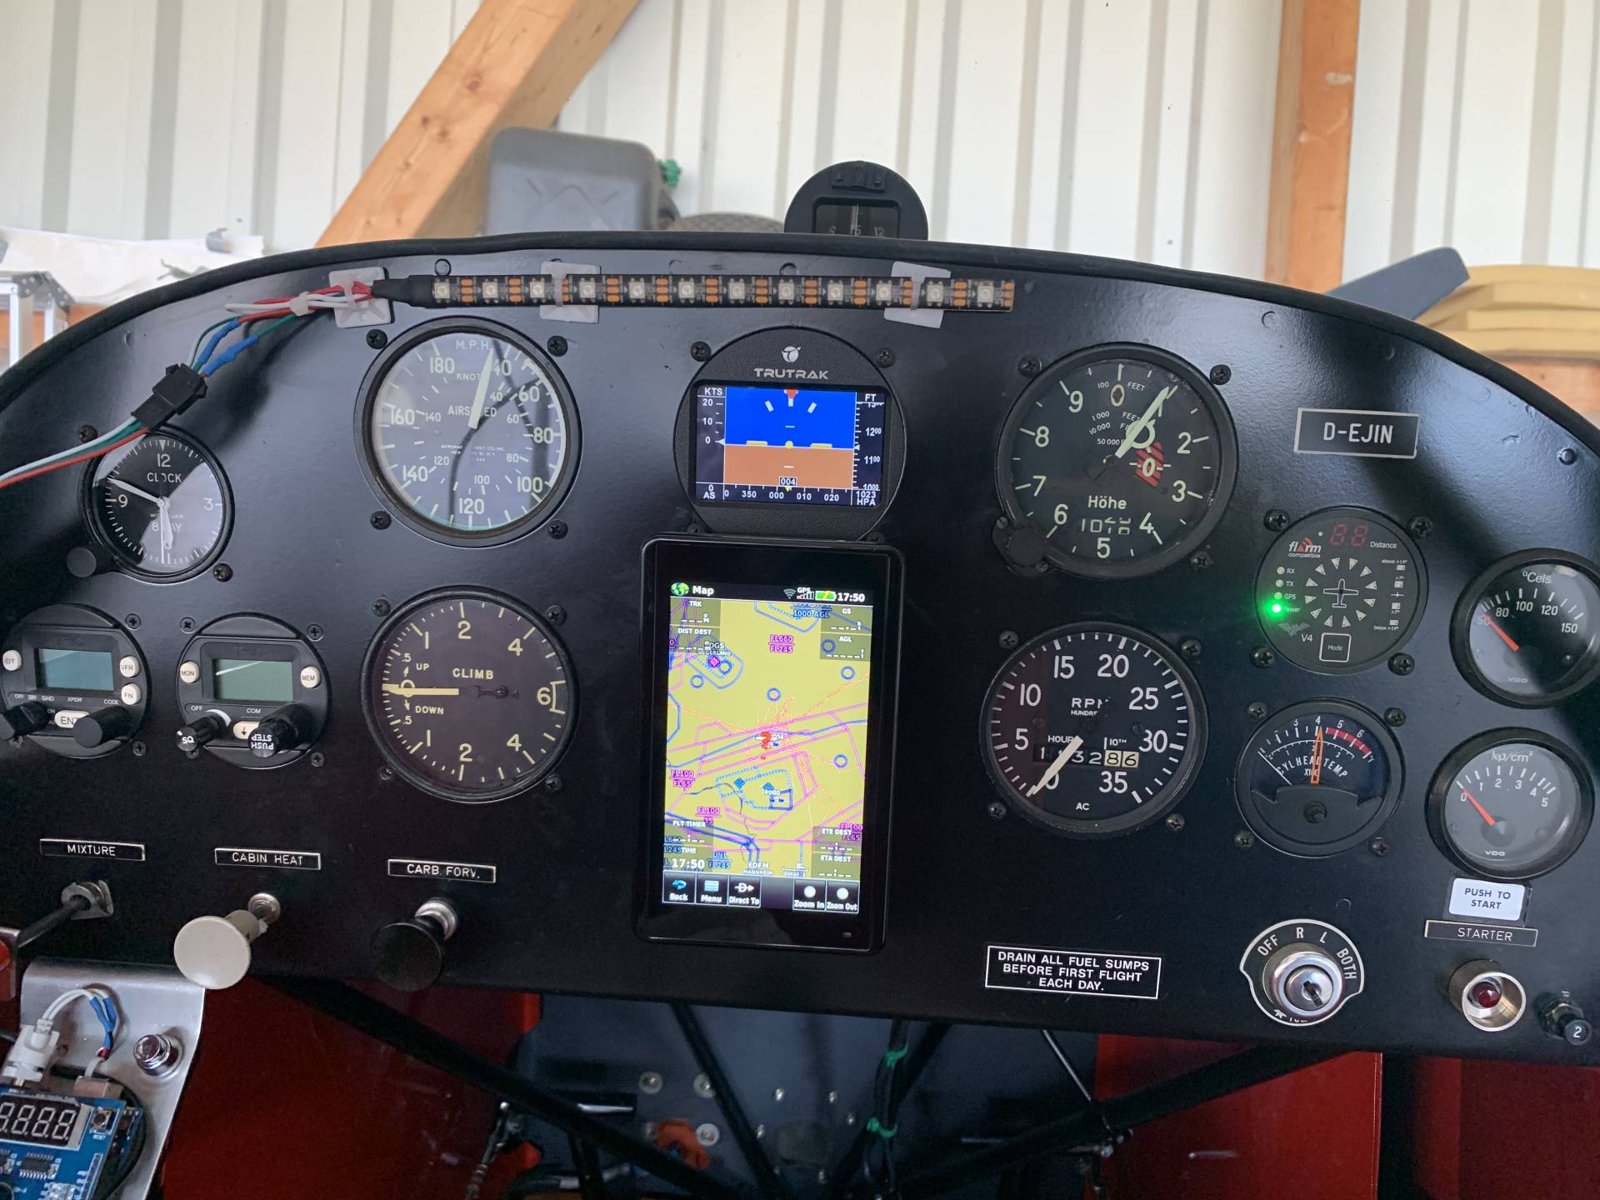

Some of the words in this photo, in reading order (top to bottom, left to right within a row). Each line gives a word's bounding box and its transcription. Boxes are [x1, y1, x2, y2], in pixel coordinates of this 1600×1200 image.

[456, 340, 493, 350] M.P.H.
[429, 357, 455, 374] 180
[492, 359, 512, 376] 40
[753, 368, 829, 380] TRUTRAK
[704, 387, 723, 396] KTS
[1097, 381, 1110, 389] 100
[1127, 381, 1146, 392] FEET
[490, 392, 503, 401] 40
[519, 385, 540, 402] 60
[865, 394, 877, 402] FT
[1110, 384, 1125, 407] 0
[1068, 391, 1084, 412] 9
[390, 409, 415, 425] 160
[425, 412, 442, 422] 140
[448, 405, 497, 418] AIRSED
[506, 414, 520, 424] 60
[702, 417, 713, 425] 10
[533, 428, 554, 444] 80
[865, 427, 882, 436] 1200
[1035, 426, 1050, 448] 8
[1323, 422, 1394, 444] D-EJIN
[705, 436, 711, 444] 0
[1177, 432, 1190, 454] 2
[157, 453, 172, 468] 12
[434, 456, 450, 465] 120
[506, 453, 519, 462] 80
[1142, 458, 1156, 477] 0
[403, 466, 428, 482] 140
[474, 475, 490, 485] 100
[517, 477, 543, 492] 100
[780, 478, 796, 486] 004
[1033, 476, 1046, 496] 7
[703, 492, 716, 500] AS
[742, 490, 757, 498] 350
[769, 491, 784, 499] 000
[796, 492, 812, 500] 010
[856, 491, 876, 499] 1023
[1172, 480, 1187, 502] 3
[118, 494, 128, 508] 9
[824, 493, 840, 502] 020
[1088, 496, 1127, 510] Höhe
[203, 498, 214, 511] 3
[459, 498, 485, 514] 120
[1054, 504, 1068, 525] 6
[151, 522, 160, 532] 8
[1139, 512, 1154, 534] 4
[1096, 537, 1110, 558] 5
[1370, 541, 1398, 550] Distance
[692, 586, 714, 596] Map
[838, 592, 866, 602] 17:50
[1516, 601, 1534, 612] 100
[1541, 604, 1558, 616] 120
[1496, 608, 1510, 618] 80
[458, 620, 472, 640] 2
[1561, 622, 1578, 634] 150
[425, 632, 430, 650] 1
[1301, 634, 1314, 642] V4
[508, 638, 523, 656] 4
[1328, 644, 1344, 652] Mode
[416, 663, 430, 671] UP
[1054, 656, 1075, 679] 15
[1097, 654, 1130, 678] 20
[302, 674, 316, 682] MEM
[452, 668, 494, 680] CLIMB
[537, 687, 551, 706] 6
[1020, 684, 1042, 706] 10
[1128, 687, 1159, 710] 25
[415, 706, 444, 715] DOWN
[1315, 716, 1321, 724] 4
[1338, 720, 1344, 728] 5
[251, 734, 272, 742] STEP
[426, 730, 431, 747] 1
[1014, 728, 1029, 750] 5
[1356, 729, 1364, 738] 6
[251, 742, 274, 751] PUSH
[506, 734, 522, 752] 4
[1109, 738, 1128, 746] 10TH
[1138, 730, 1168, 754] 30
[459, 744, 472, 762] 2
[1276, 760, 1295, 775] CYL
[1324, 758, 1349, 778] TEMP
[1099, 771, 1128, 794] 35
[1479, 782, 1484, 792] 1
[1495, 778, 1502, 788] 2
[1515, 780, 1522, 790] 3
[1530, 787, 1537, 798] 4
[1076, 802, 1090, 811] AC
[1542, 798, 1548, 808] 5
[67, 844, 117, 857] MIXTURE
[232, 852, 268, 864] CABIN
[274, 854, 304, 866] HEAT
[672, 858, 705, 868] 17:50
[446, 866, 481, 879] FORV.
[670, 893, 688, 902] Back
[701, 894, 722, 903] Menu
[1464, 887, 1492, 898] PUSH
[1498, 890, 1511, 900] TO
[728, 896, 748, 905] Direct
[749, 897, 760, 906] To
[794, 900, 814, 908] Zoom
[827, 902, 844, 910] Zoom
[844, 902, 858, 912] Out
[1471, 899, 1502, 910] START
[1296, 926, 1304, 939] R
[1319, 931, 1328, 944] L
[1457, 927, 1513, 942] STARTER
[1257, 934, 1279, 956] OFF
[998, 951, 1036, 964] DRAIN
[1041, 955, 1064, 966] ALL
[1068, 956, 1100, 968] FUEL
[1105, 959, 1150, 972] SUMPS
[1336, 948, 1358, 980] BOTH
[1003, 963, 1053, 976] BEFORE
[1058, 967, 1094, 980] FIRST
[1099, 970, 1143, 983] FLIGHT
[1038, 978, 1073, 990] EACH
[1078, 980, 1105, 992] DAY.
[1572, 1026, 1582, 1038] 2
